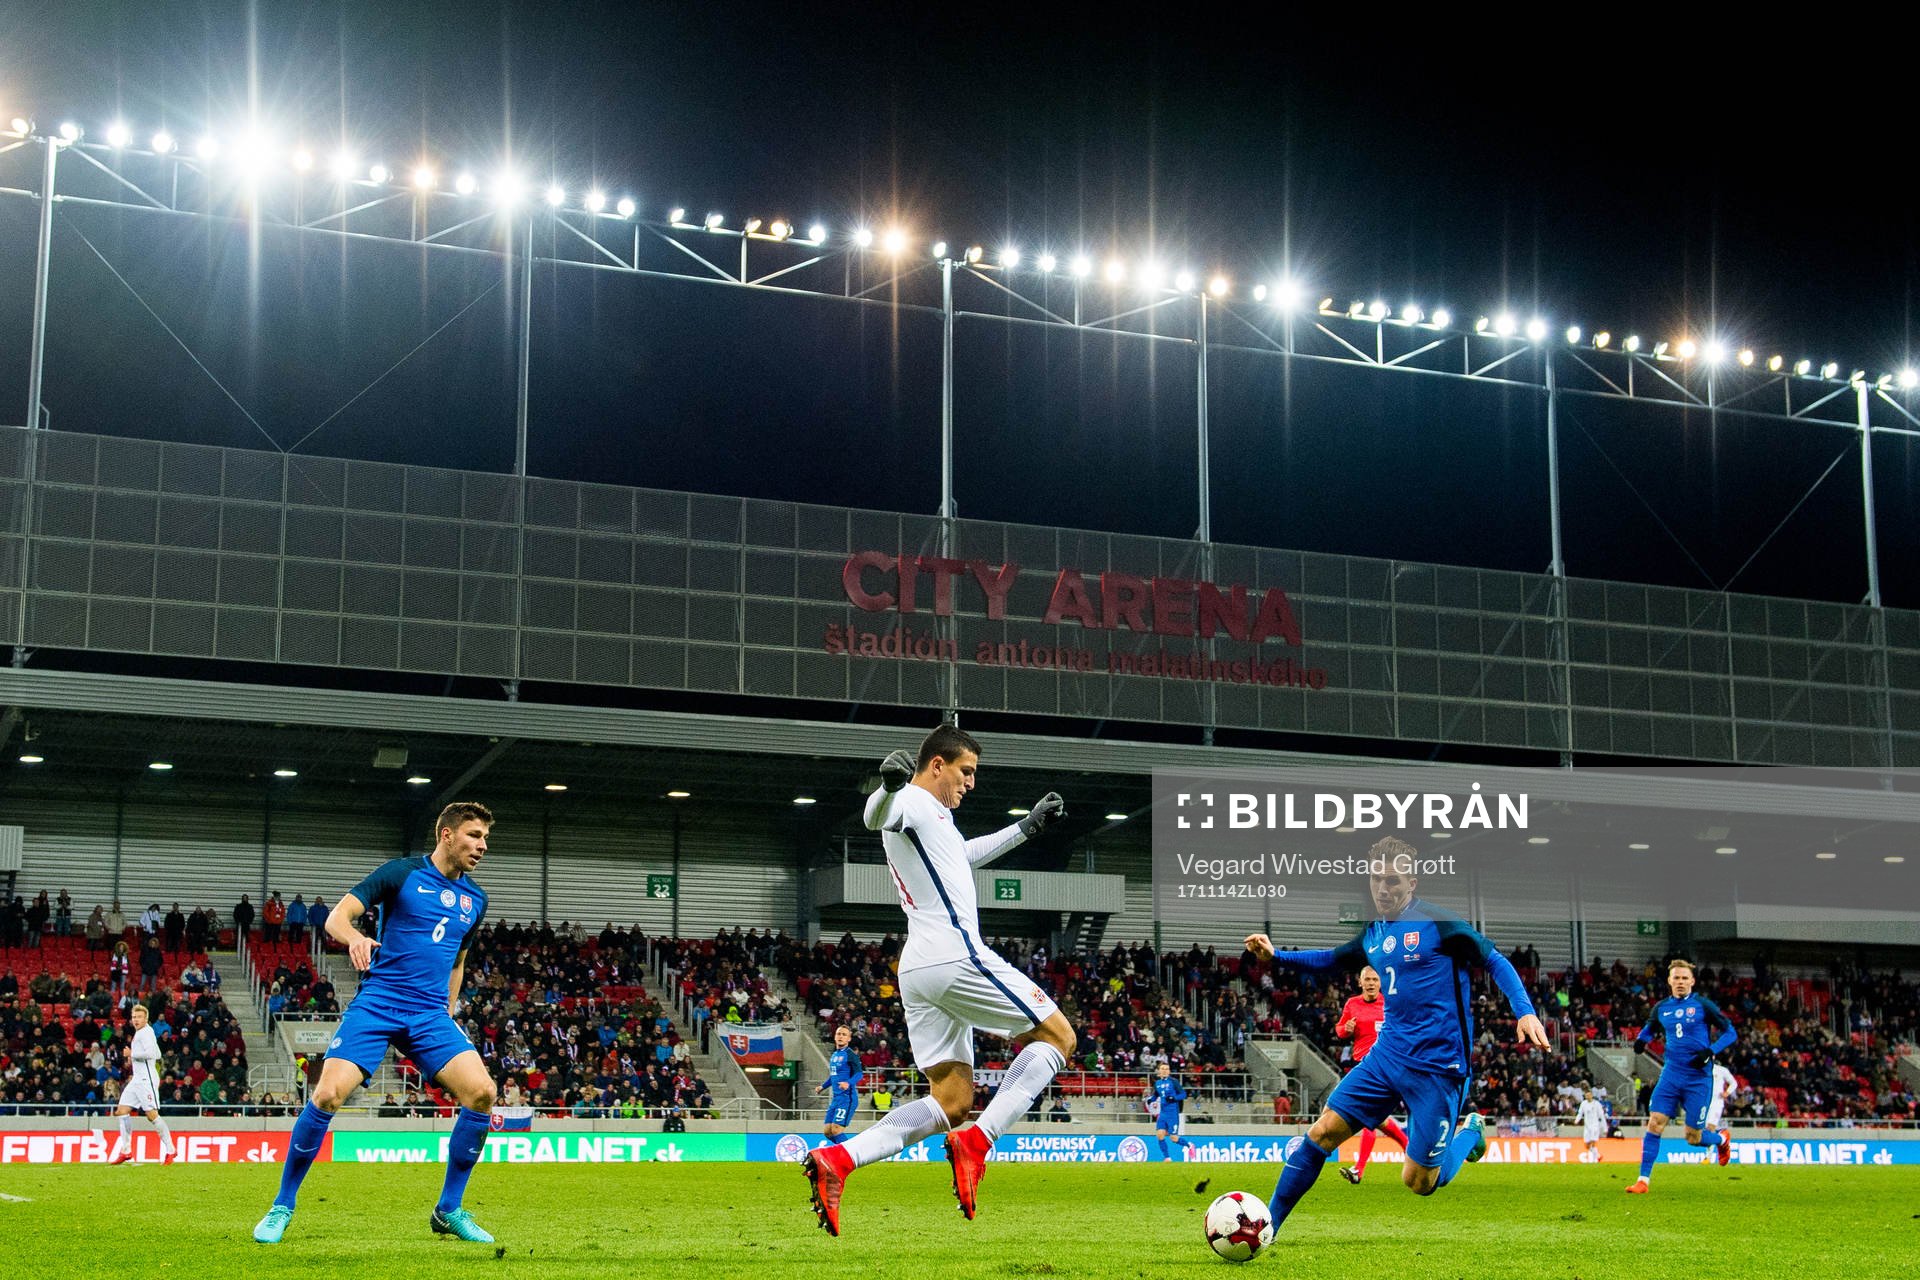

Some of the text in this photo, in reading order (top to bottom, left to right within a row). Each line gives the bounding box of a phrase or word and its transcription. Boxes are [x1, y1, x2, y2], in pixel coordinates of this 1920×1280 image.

[843, 551, 1302, 647] CITY ARENA
[976, 638, 1094, 672] antona
[1000, 887, 1016, 899] 23
[432, 916, 450, 943] 6
[1643, 923, 1656, 933] 26
[1385, 965, 1399, 995] 2
[1675, 1022, 1684, 1039] 8
[776, 1067, 791, 1078] 24
[836, 1108, 847, 1119] 22
[1700, 1105, 1707, 1120] 8
[1435, 1119, 1450, 1148] 2
[1016, 1135, 1097, 1150] SLOVENSKÝ
